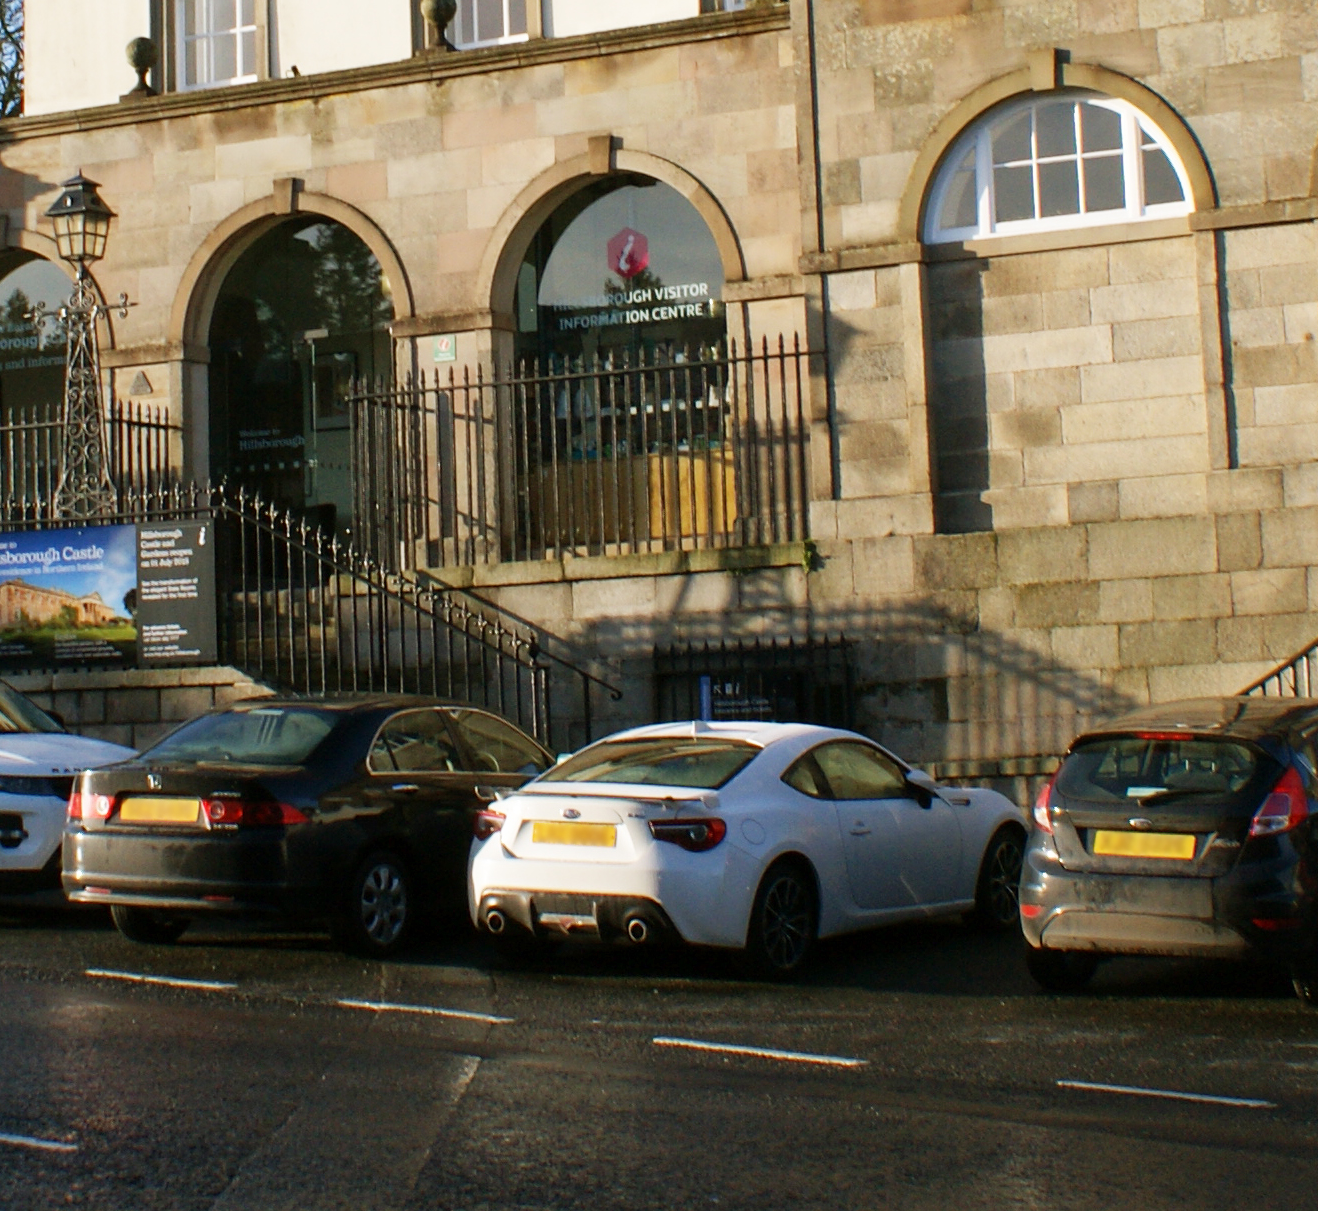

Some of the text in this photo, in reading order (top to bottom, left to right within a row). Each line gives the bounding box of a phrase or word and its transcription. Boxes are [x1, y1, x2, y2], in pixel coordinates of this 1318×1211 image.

[552, 282, 709, 311] HIBOROUGH VISITOR
[559, 303, 703, 331] INFORMATION CENTRE
[28, 355, 68, 367] inform
[239, 435, 305, 450] Hillsborough
[62, 545, 105, 561] Castle
